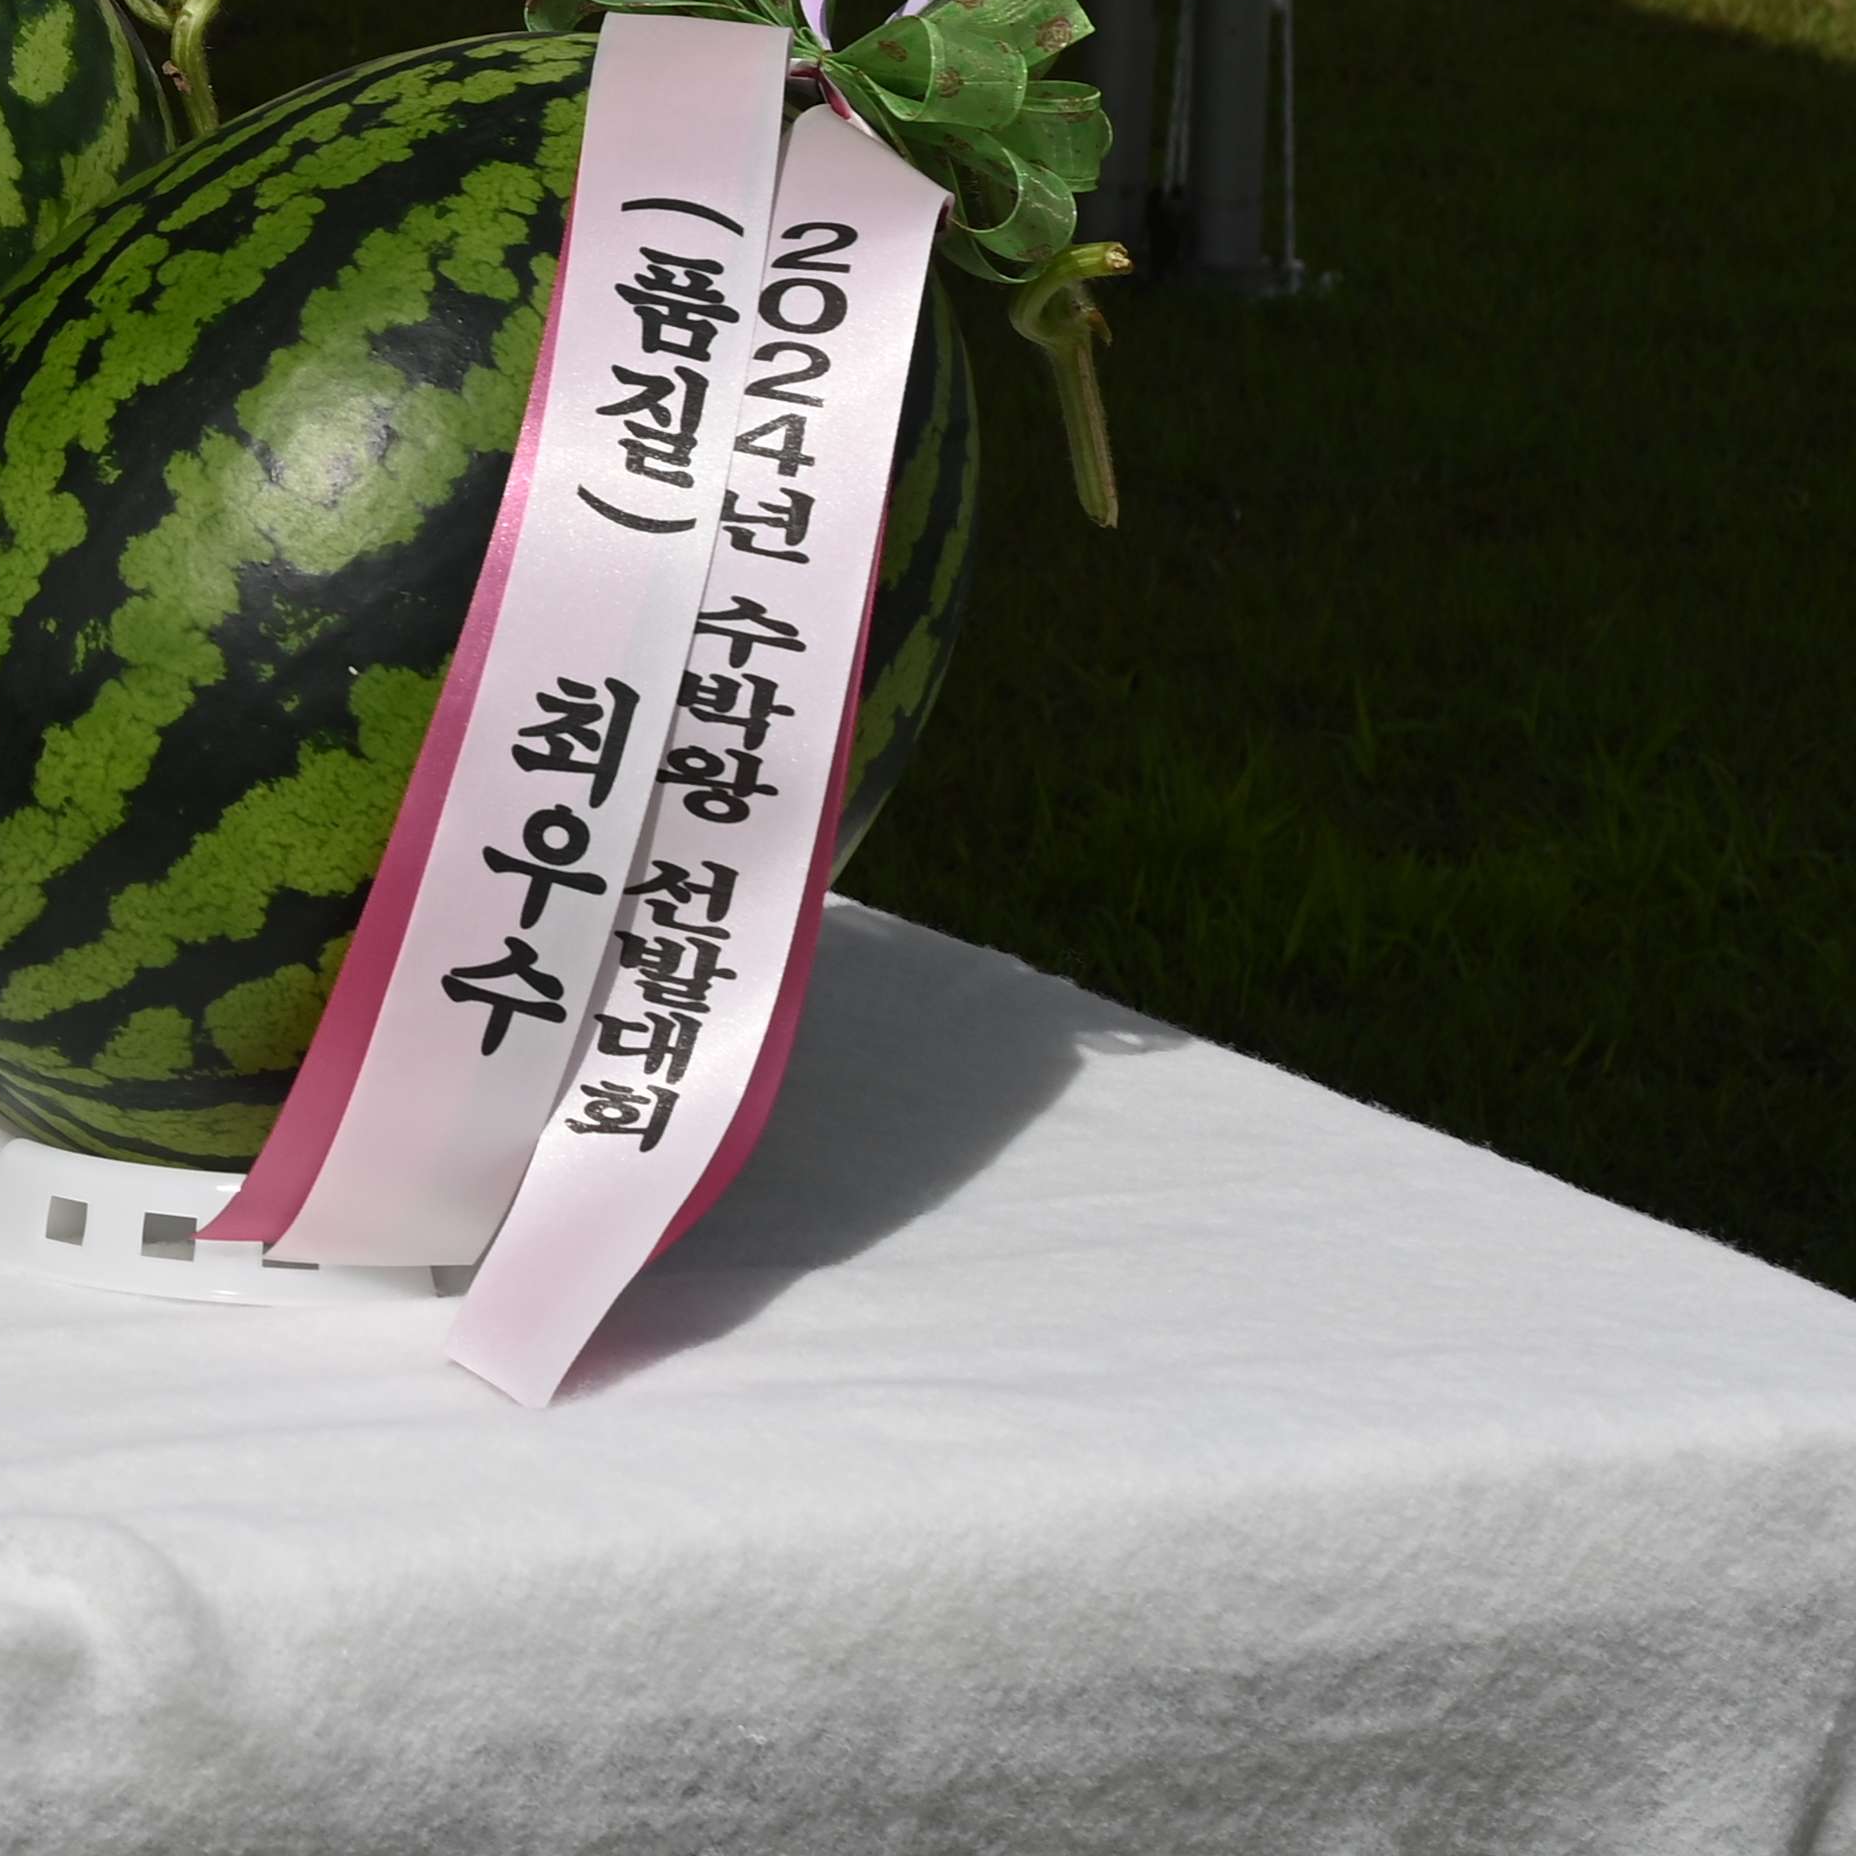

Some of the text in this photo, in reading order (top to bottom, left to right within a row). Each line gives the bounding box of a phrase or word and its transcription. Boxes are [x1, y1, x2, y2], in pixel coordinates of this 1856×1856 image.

[438, 196, 745, 1060] (품질) 최우수
[562, 220, 861, 1157] 2024년 수박왕 선발대회
